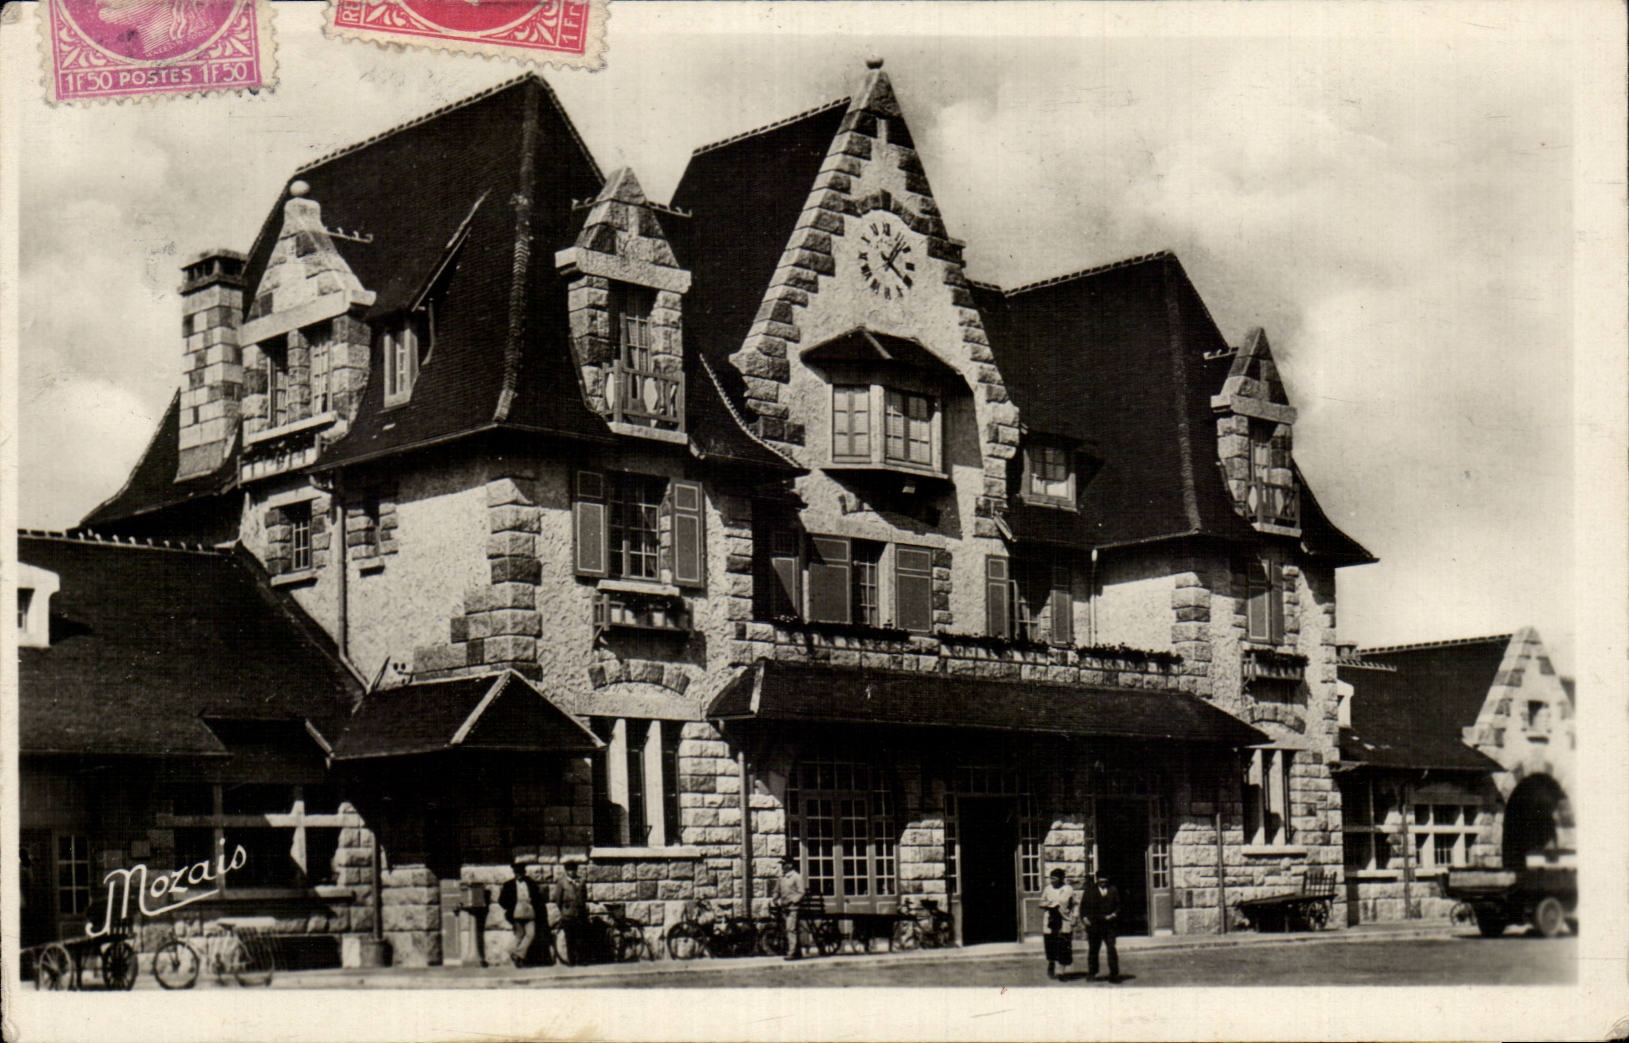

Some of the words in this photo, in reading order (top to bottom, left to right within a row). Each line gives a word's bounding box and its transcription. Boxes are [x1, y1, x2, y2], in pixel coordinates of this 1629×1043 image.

[65, 71, 113, 91] 1F50
[119, 68, 193, 87] POSTES
[201, 62, 248, 83] 1F50
